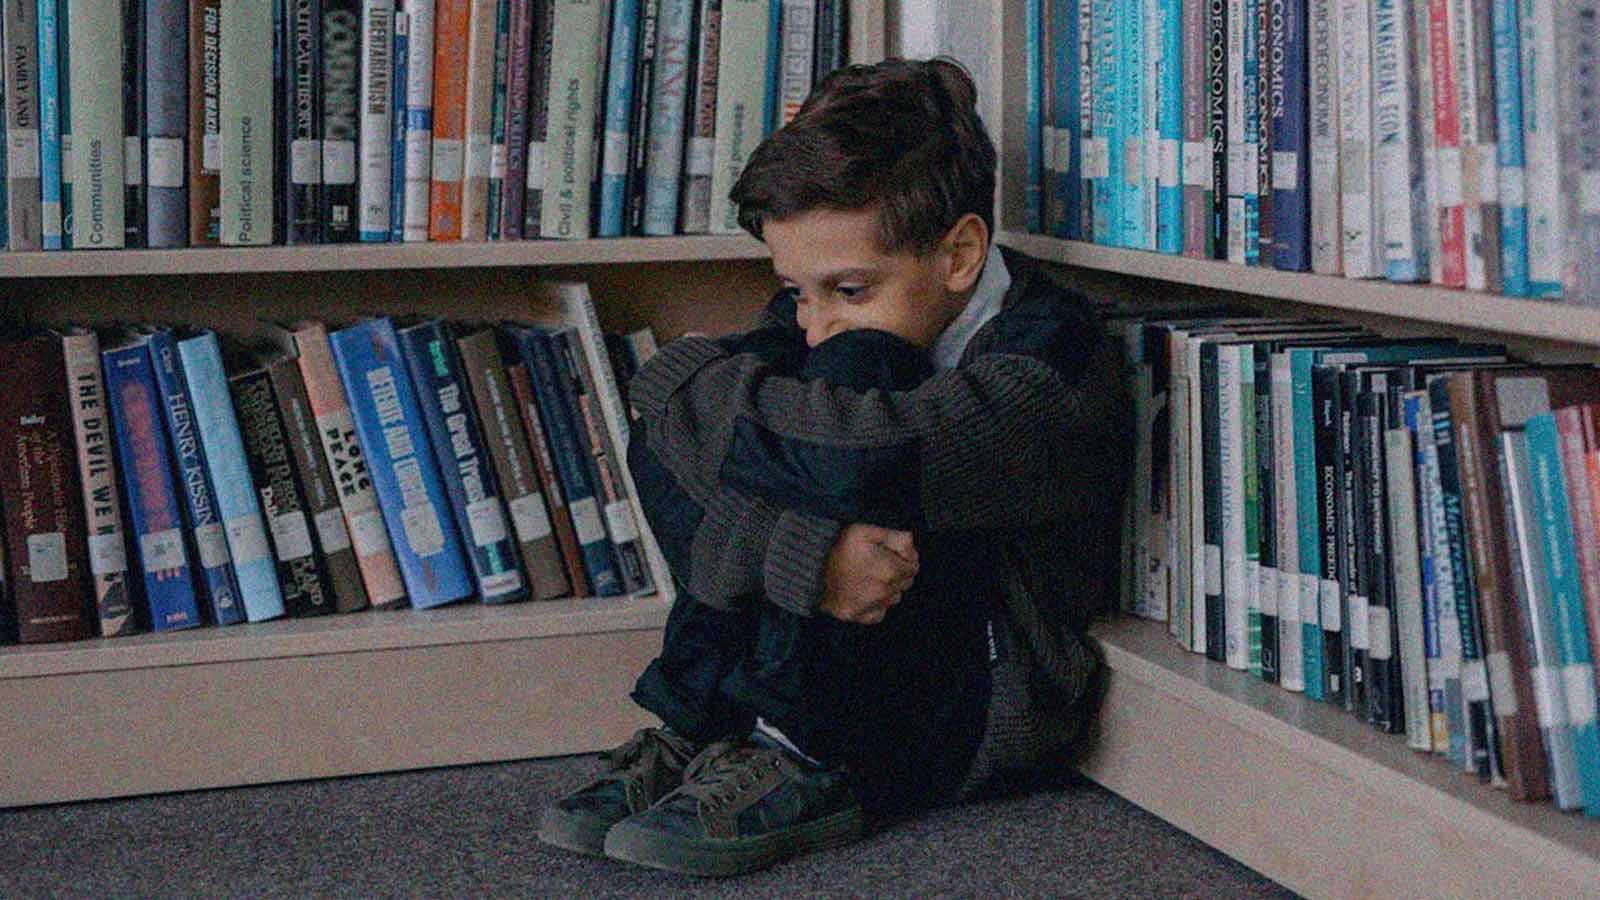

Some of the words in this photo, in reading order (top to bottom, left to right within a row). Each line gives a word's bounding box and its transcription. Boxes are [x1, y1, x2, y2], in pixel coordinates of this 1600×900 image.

[204, 7, 218, 33] FOR
[296, 0, 313, 67] OLITICAL
[15, 45, 28, 92] FAMILY
[204, 36, 218, 94] DECISION
[368, 8, 388, 115] LIBERTARIANISM
[1211, 0, 1224, 153] OECONOMICS
[1270, 0, 1285, 118] CONOMICS
[16, 96, 29, 128] AND
[566, 79, 581, 122] rights
[239, 117, 252, 175] science
[562, 125, 579, 184] political
[89, 139, 103, 245] Communities
[238, 181, 252, 243] Political
[558, 203, 572, 236] Civil
[77, 372, 98, 411] THE
[437, 381, 461, 413] The
[82, 417, 104, 478] DEVIL
[166, 392, 199, 460] HENRY
[184, 465, 215, 527] KISSIN
[325, 427, 356, 498] PEACE
[343, 429, 371, 492] LONG
[446, 412, 476, 458] Great
[92, 485, 114, 518] WE
[1324, 464, 1337, 534] ECONOMIC
[1328, 535, 1339, 580] FREEDO
